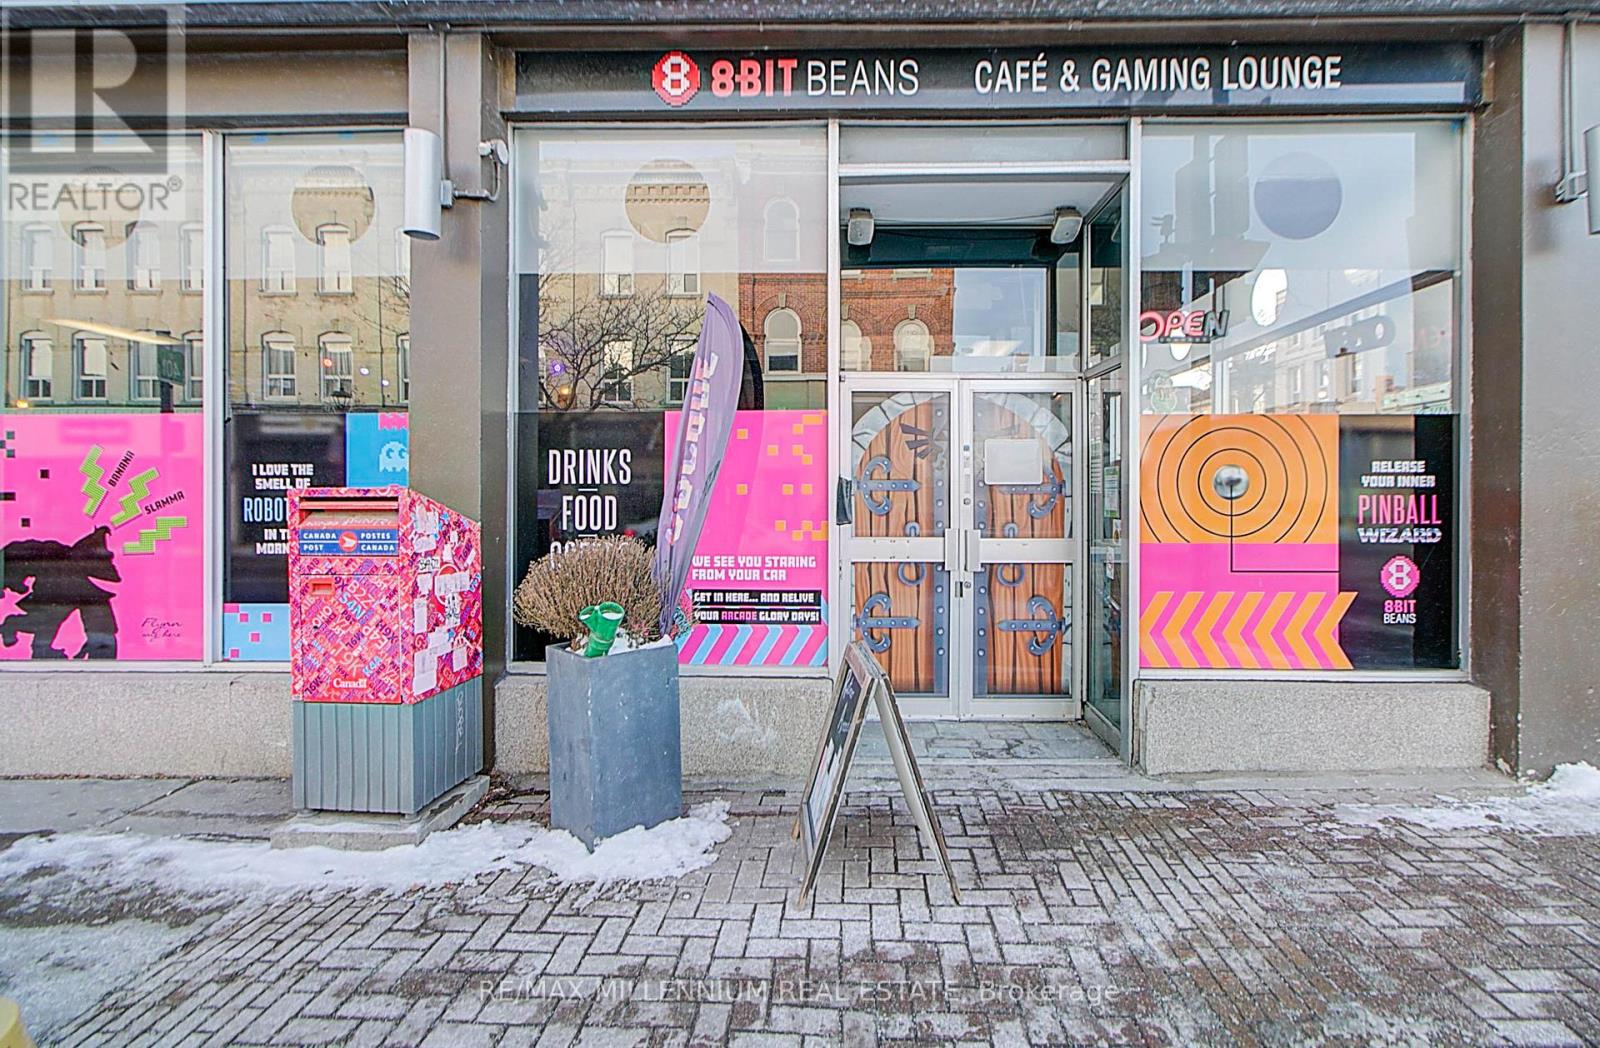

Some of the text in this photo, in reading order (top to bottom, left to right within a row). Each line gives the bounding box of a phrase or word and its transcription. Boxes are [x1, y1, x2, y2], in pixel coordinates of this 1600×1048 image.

[711, 59, 920, 97] 8-BIT BEANS
[974, 52, 1342, 94] CAFÉ & GAMING LOUNGE
[1140, 310, 1230, 341] OPEN
[108, 450, 135, 487] BANANA
[252, 464, 314, 476] I LOVE THE
[548, 449, 632, 485] DRINKS
[1371, 460, 1426, 473] RELEASE
[255, 478, 311, 490] SMELL OF
[1361, 475, 1436, 487] YOUR INNER
[144, 490, 185, 515] SLAMMA
[562, 495, 618, 531] FOOD
[1358, 494, 1442, 525] PINBALL
[263, 529, 277, 540] IN
[303, 532, 337, 540] CANADA
[360, 532, 391, 540] POSTES
[1357, 527, 1442, 543] WIZARD
[692, 556, 816, 567] WE SEE YOU STARING
[692, 569, 787, 580] FROM YOUR CAR
[694, 592, 814, 602] GET IN HERE... AND RELIVE
[694, 611, 820, 621] YOUR ARCADE GLORY DAYS!
[1383, 613, 1417, 623] BEANS
